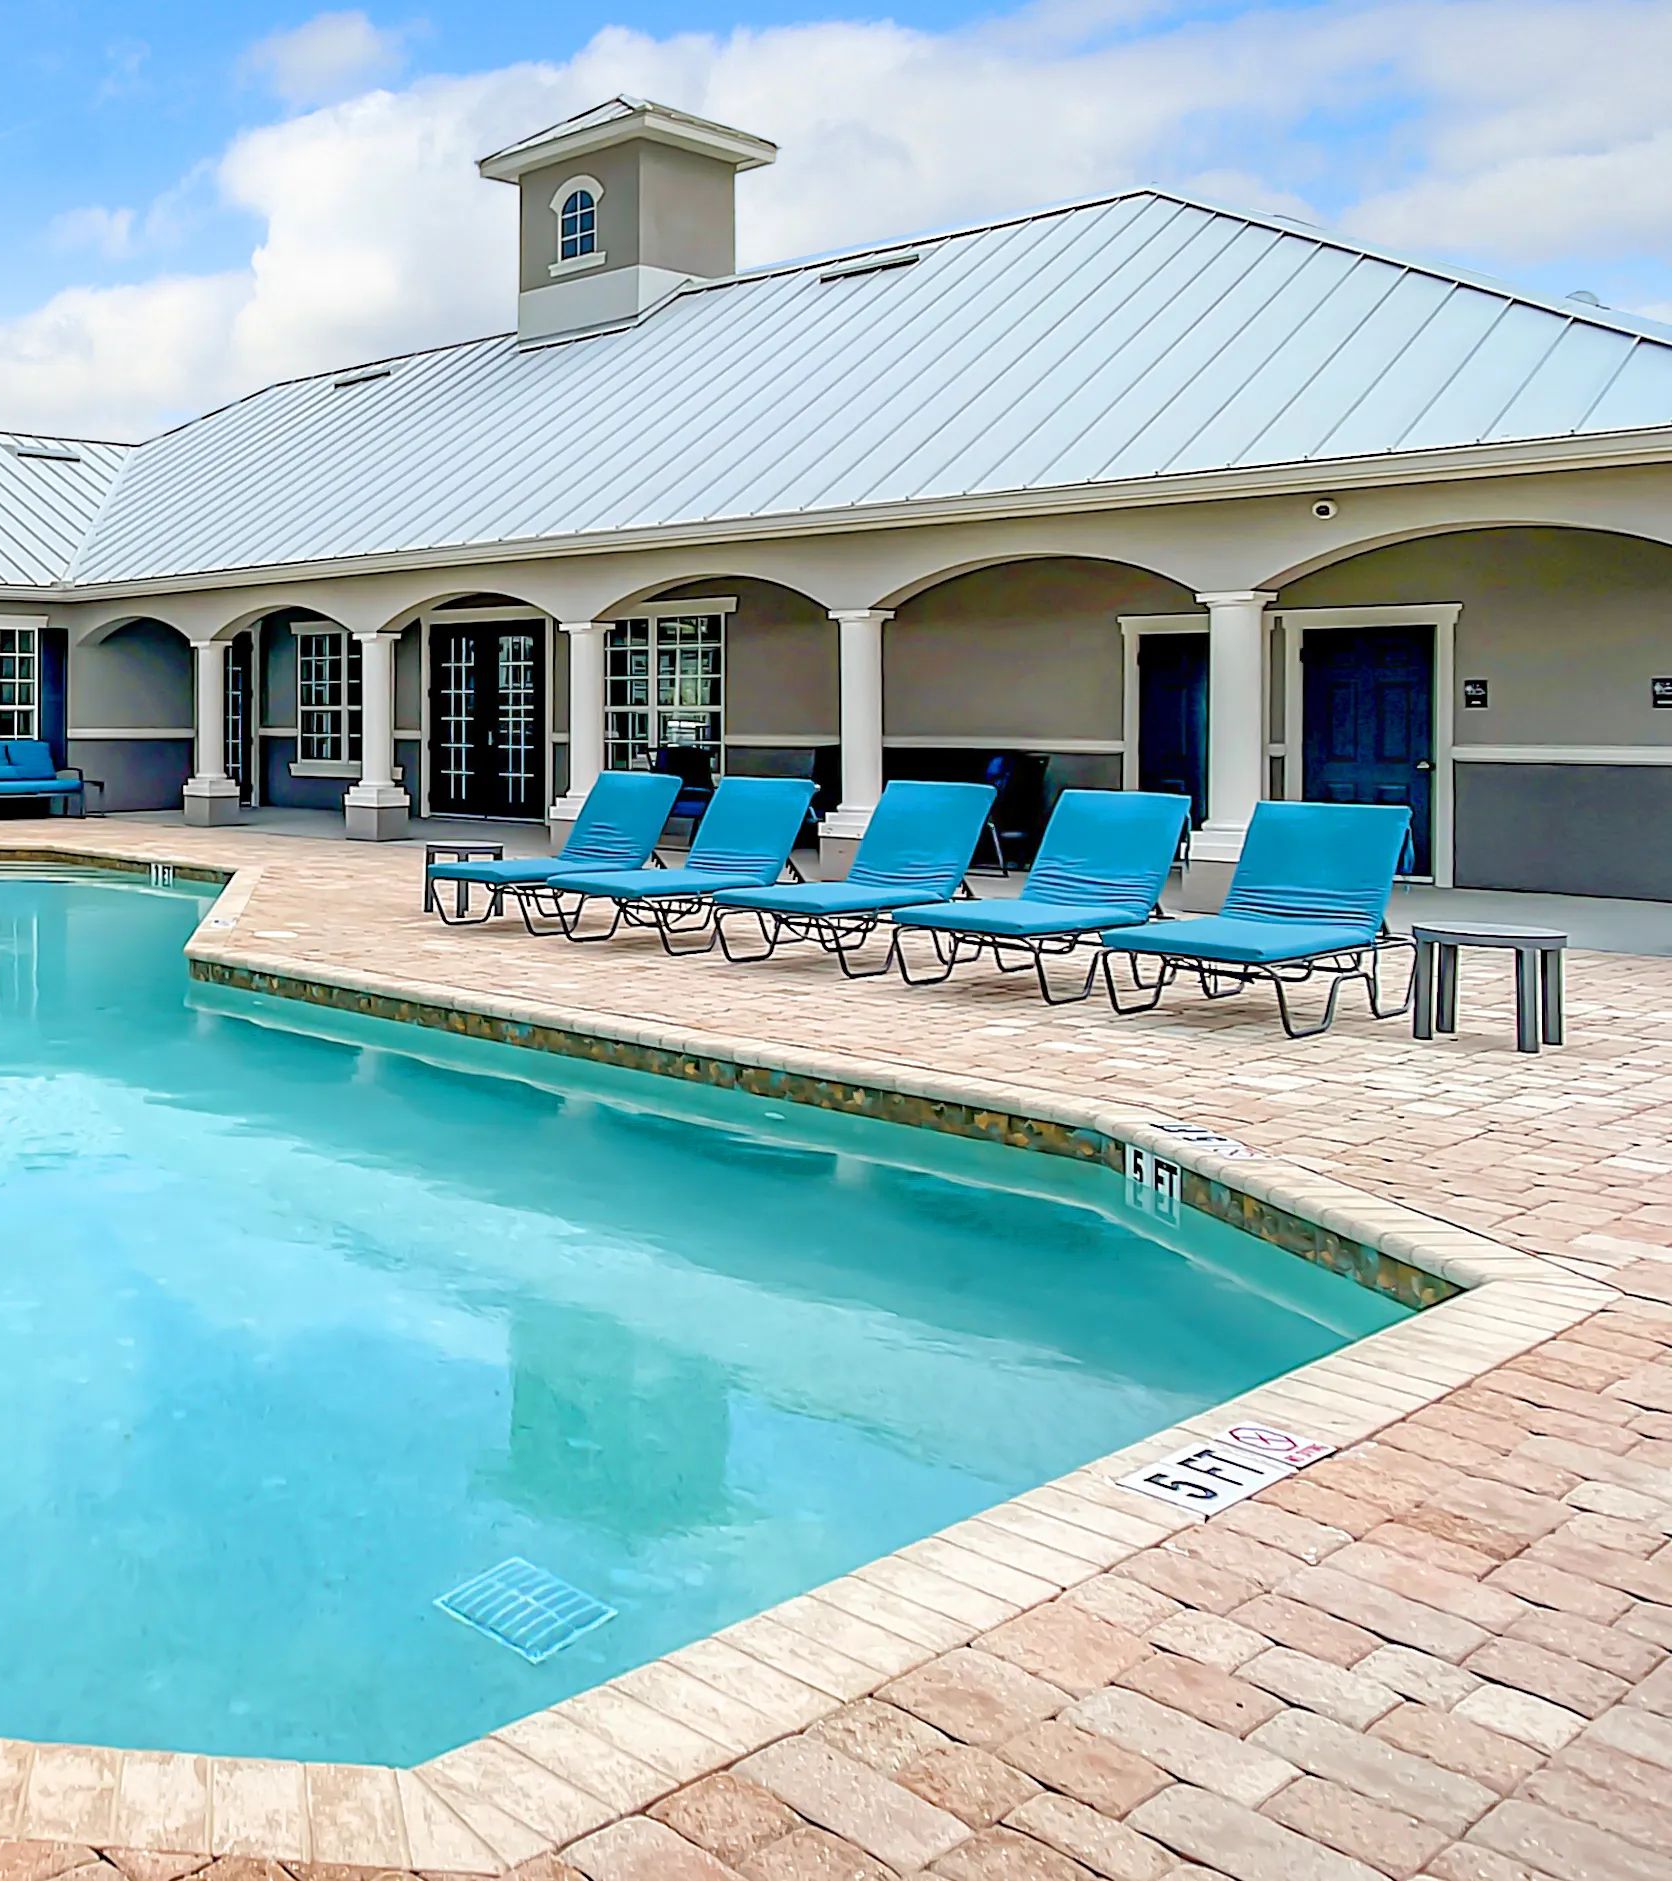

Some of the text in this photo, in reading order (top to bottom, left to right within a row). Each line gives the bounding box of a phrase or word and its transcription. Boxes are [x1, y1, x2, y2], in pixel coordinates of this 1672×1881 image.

[1133, 1148, 1178, 1198] 5 FT
[1143, 1472, 1219, 1500] 5
[1177, 1448, 1265, 1487] FT
